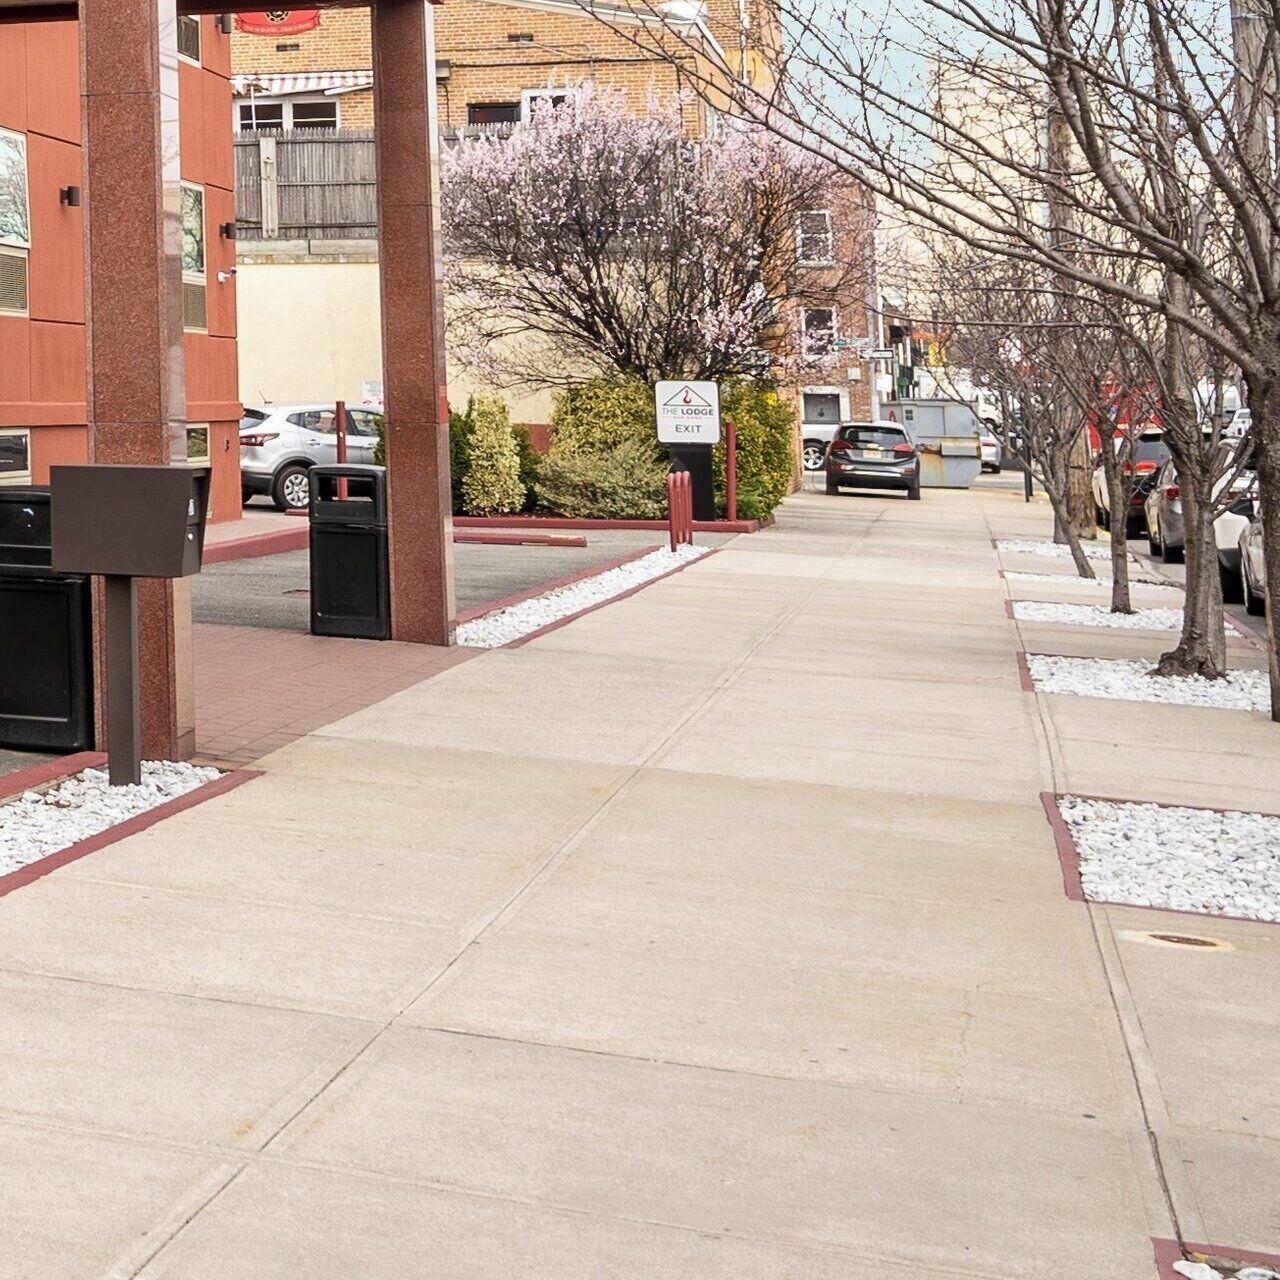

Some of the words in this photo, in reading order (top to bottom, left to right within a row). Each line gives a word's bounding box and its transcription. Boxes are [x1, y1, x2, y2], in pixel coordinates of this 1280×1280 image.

[662, 407, 678, 416] THE
[681, 408, 715, 416] LODGE
[675, 424, 702, 434] EXIT
